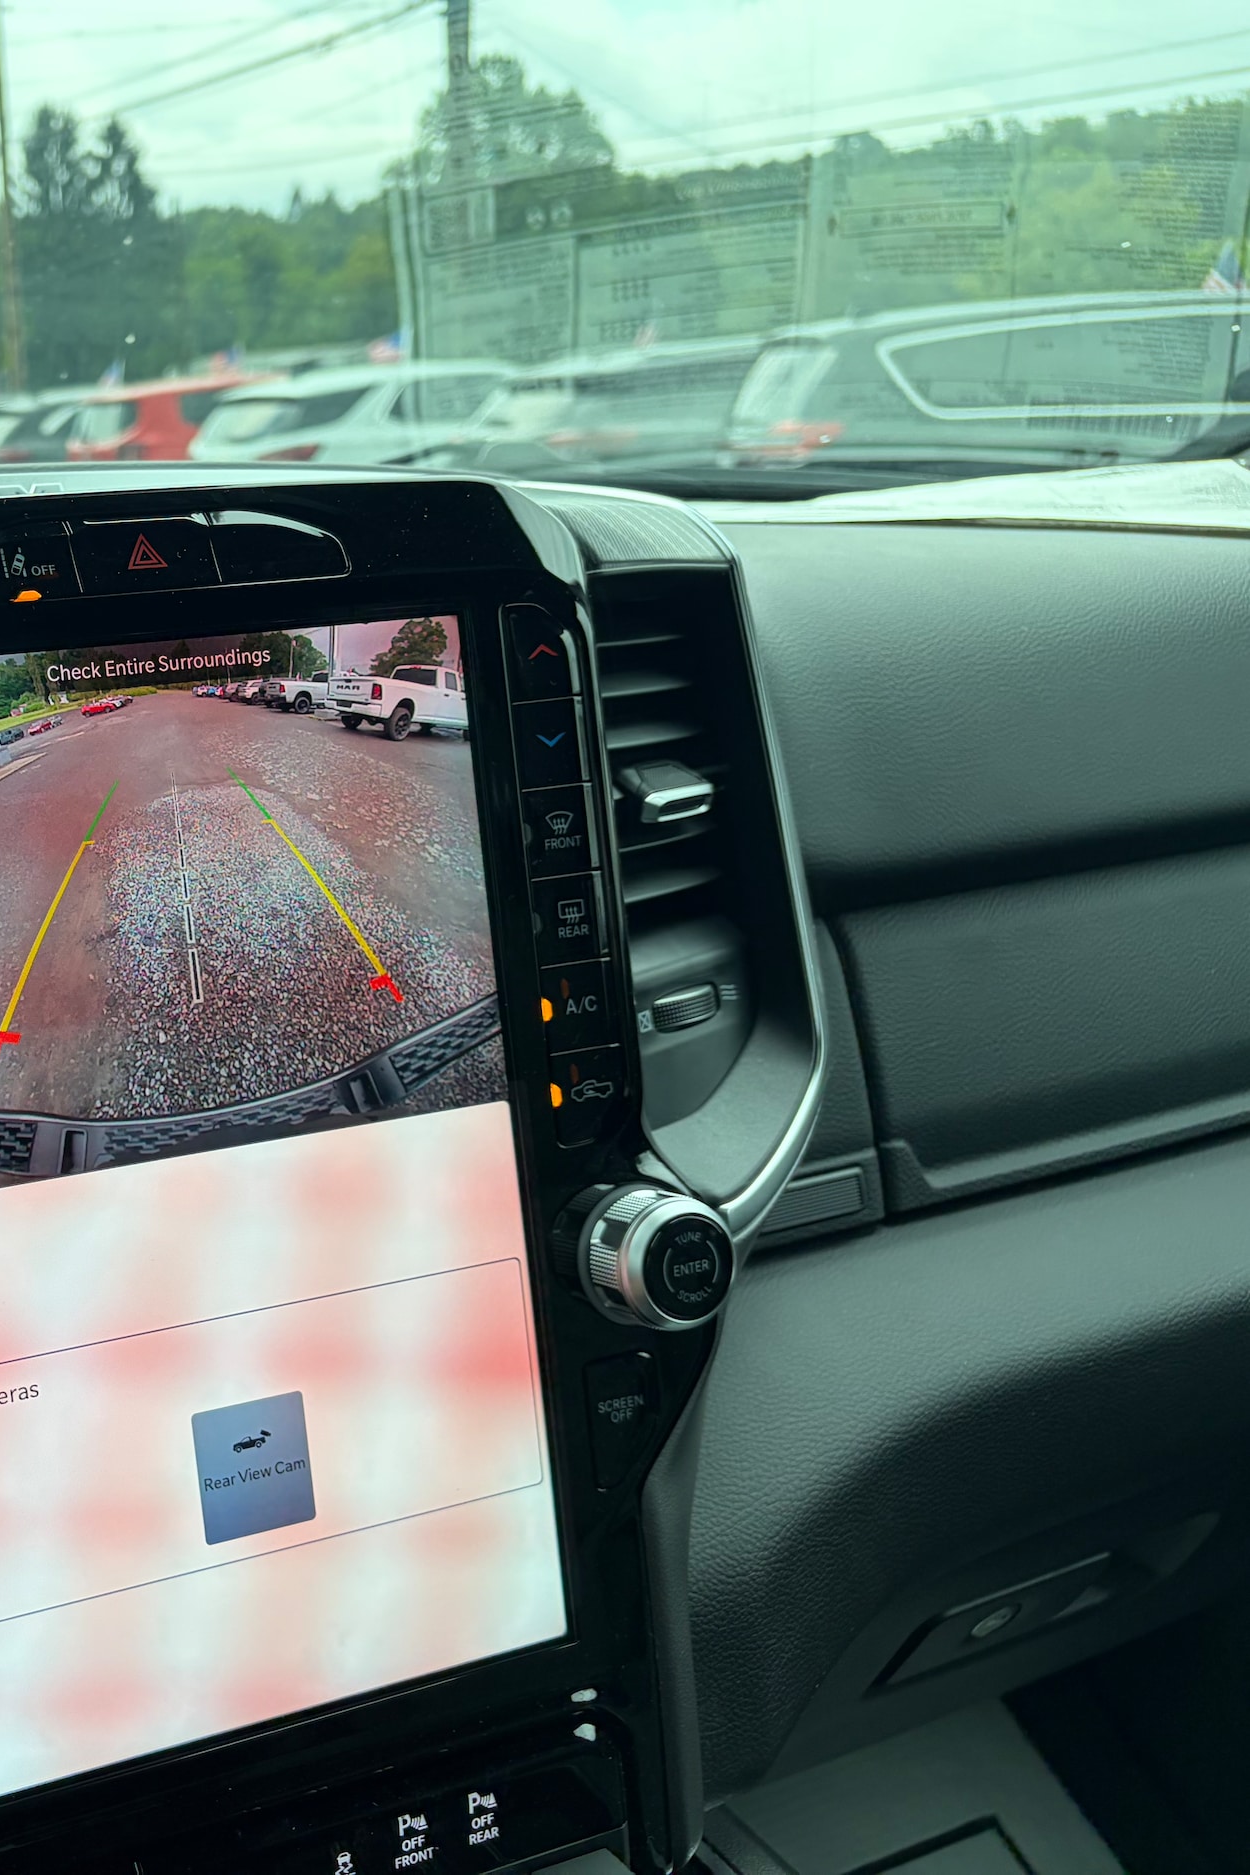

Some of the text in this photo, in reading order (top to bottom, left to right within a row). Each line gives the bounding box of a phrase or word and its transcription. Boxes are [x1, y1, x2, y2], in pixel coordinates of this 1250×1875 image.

[31, 564, 57, 577] OFF
[46, 648, 272, 683] Check Entire Surroundings
[544, 834, 583, 851] FRONT
[557, 924, 590, 939] REAR
[565, 995, 598, 1016] A/C
[674, 1231, 701, 1246] TUNE
[673, 1258, 711, 1278] ENTER
[676, 1285, 713, 1304] SCROLL
[597, 1394, 645, 1414] SCREEN
[610, 1407, 634, 1424] OFF
[203, 1457, 307, 1492] Rear View Cam
[471, 1812, 495, 1830] OFF
[401, 1834, 426, 1852] OFF
[468, 1827, 500, 1846] REAR
[394, 1847, 435, 1870] FRONT
